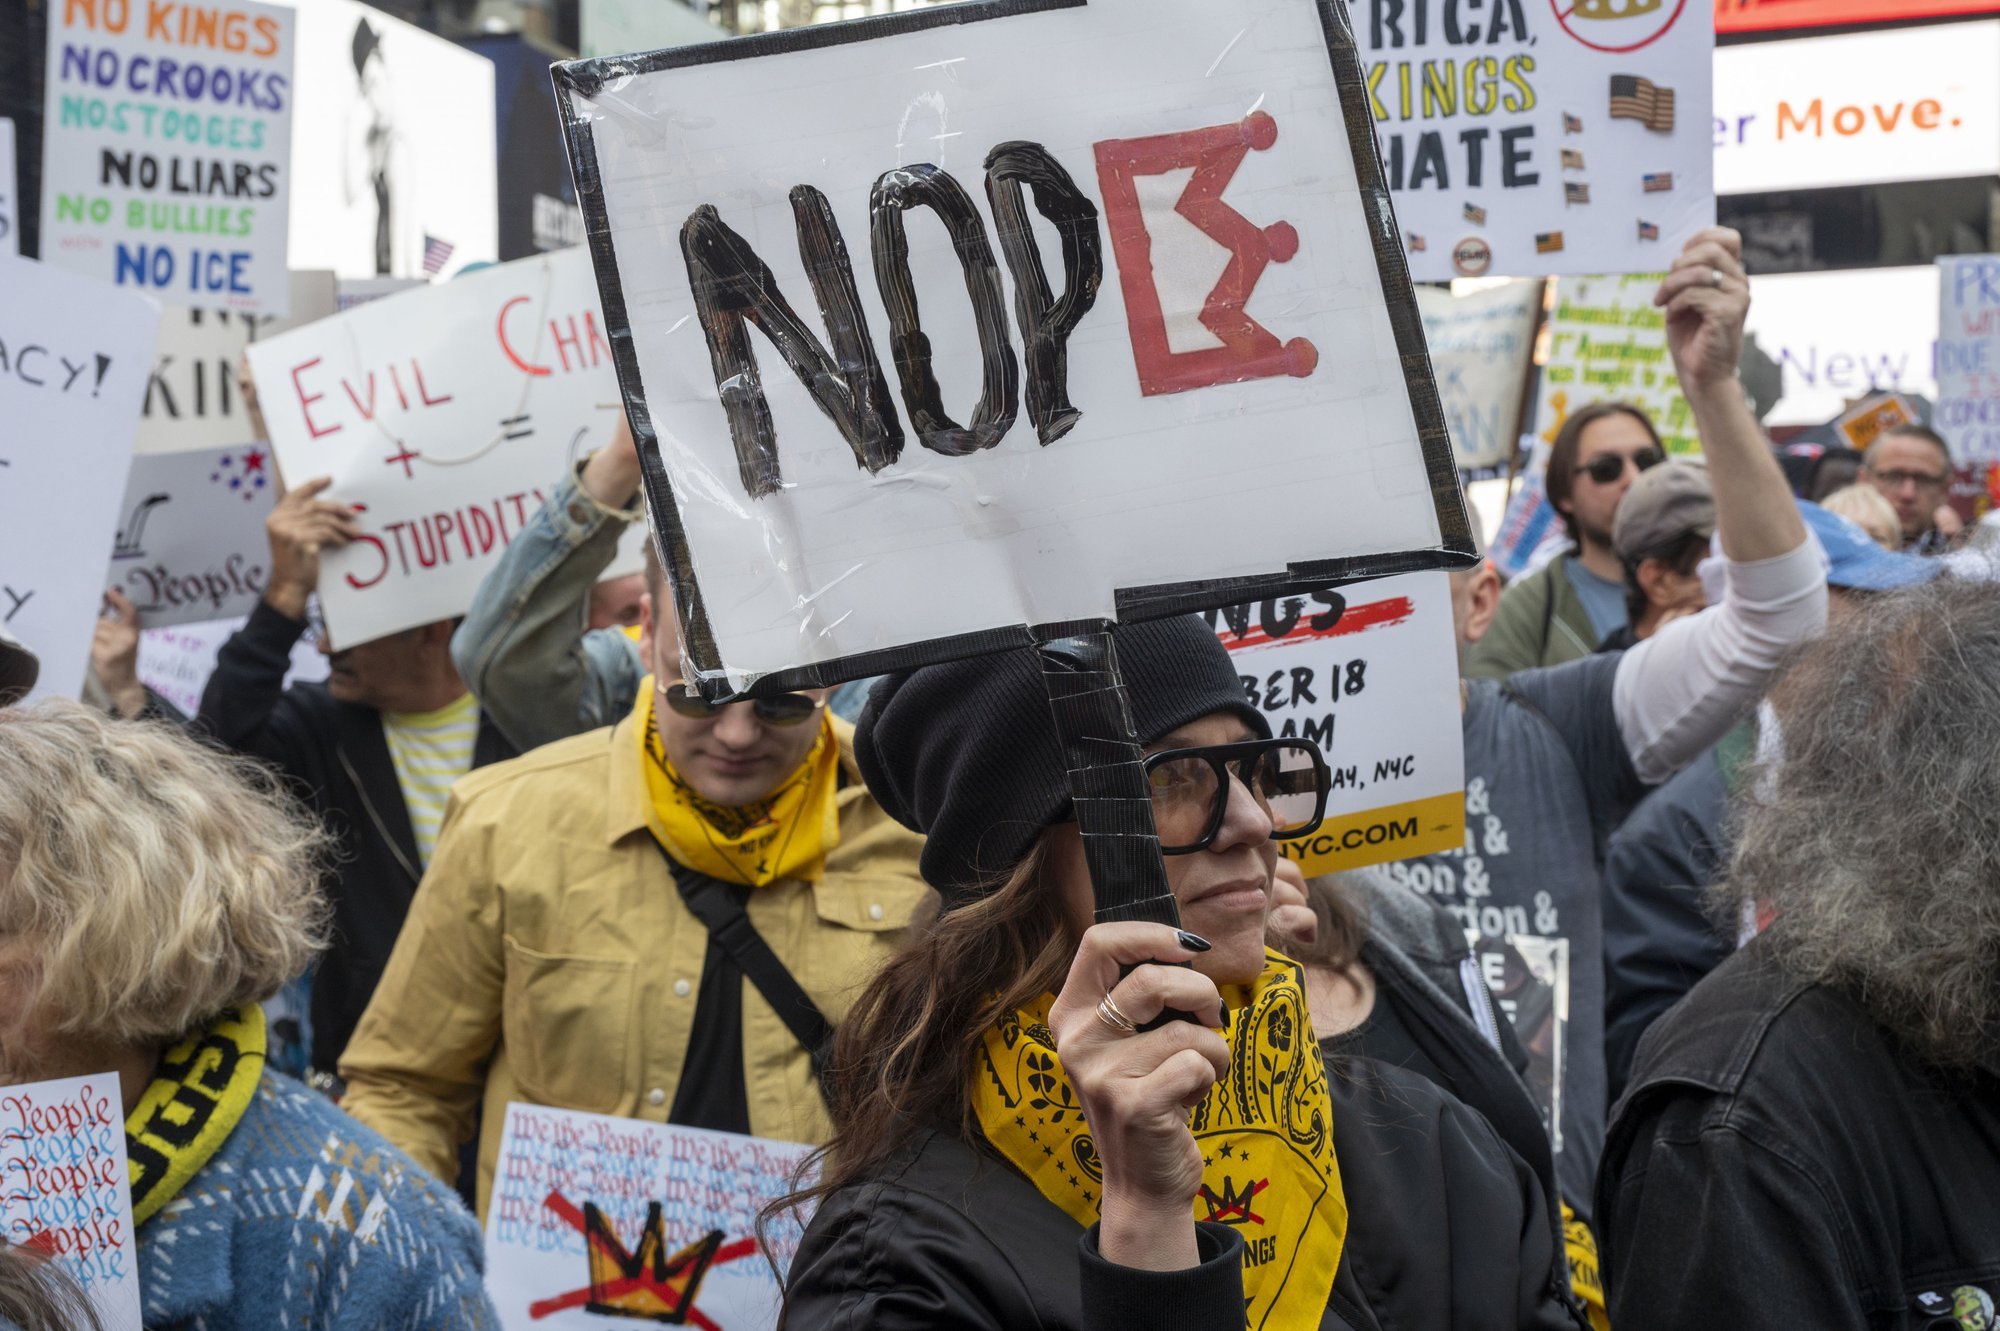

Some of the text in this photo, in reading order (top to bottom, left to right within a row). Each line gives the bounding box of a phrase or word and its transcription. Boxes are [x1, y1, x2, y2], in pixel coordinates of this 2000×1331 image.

[63, 0, 279, 58] NO KINGS
[126, 55, 288, 112] CROOKS
[1776, 98, 1961, 141] Move.
[101, 148, 278, 199] NO LIARS
[56, 193, 256, 238] NO BULLIES
[115, 242, 254, 294] NO ICE
[679, 110, 1319, 501] NOPE
[291, 357, 454, 440] EVIL
[1331, 658, 1367, 703] 18
[1373, 754, 1415, 783] NYC
[2, 1085, 115, 1139] People
[513, 1111, 548, 1143] We
[8, 1146, 120, 1201] People
